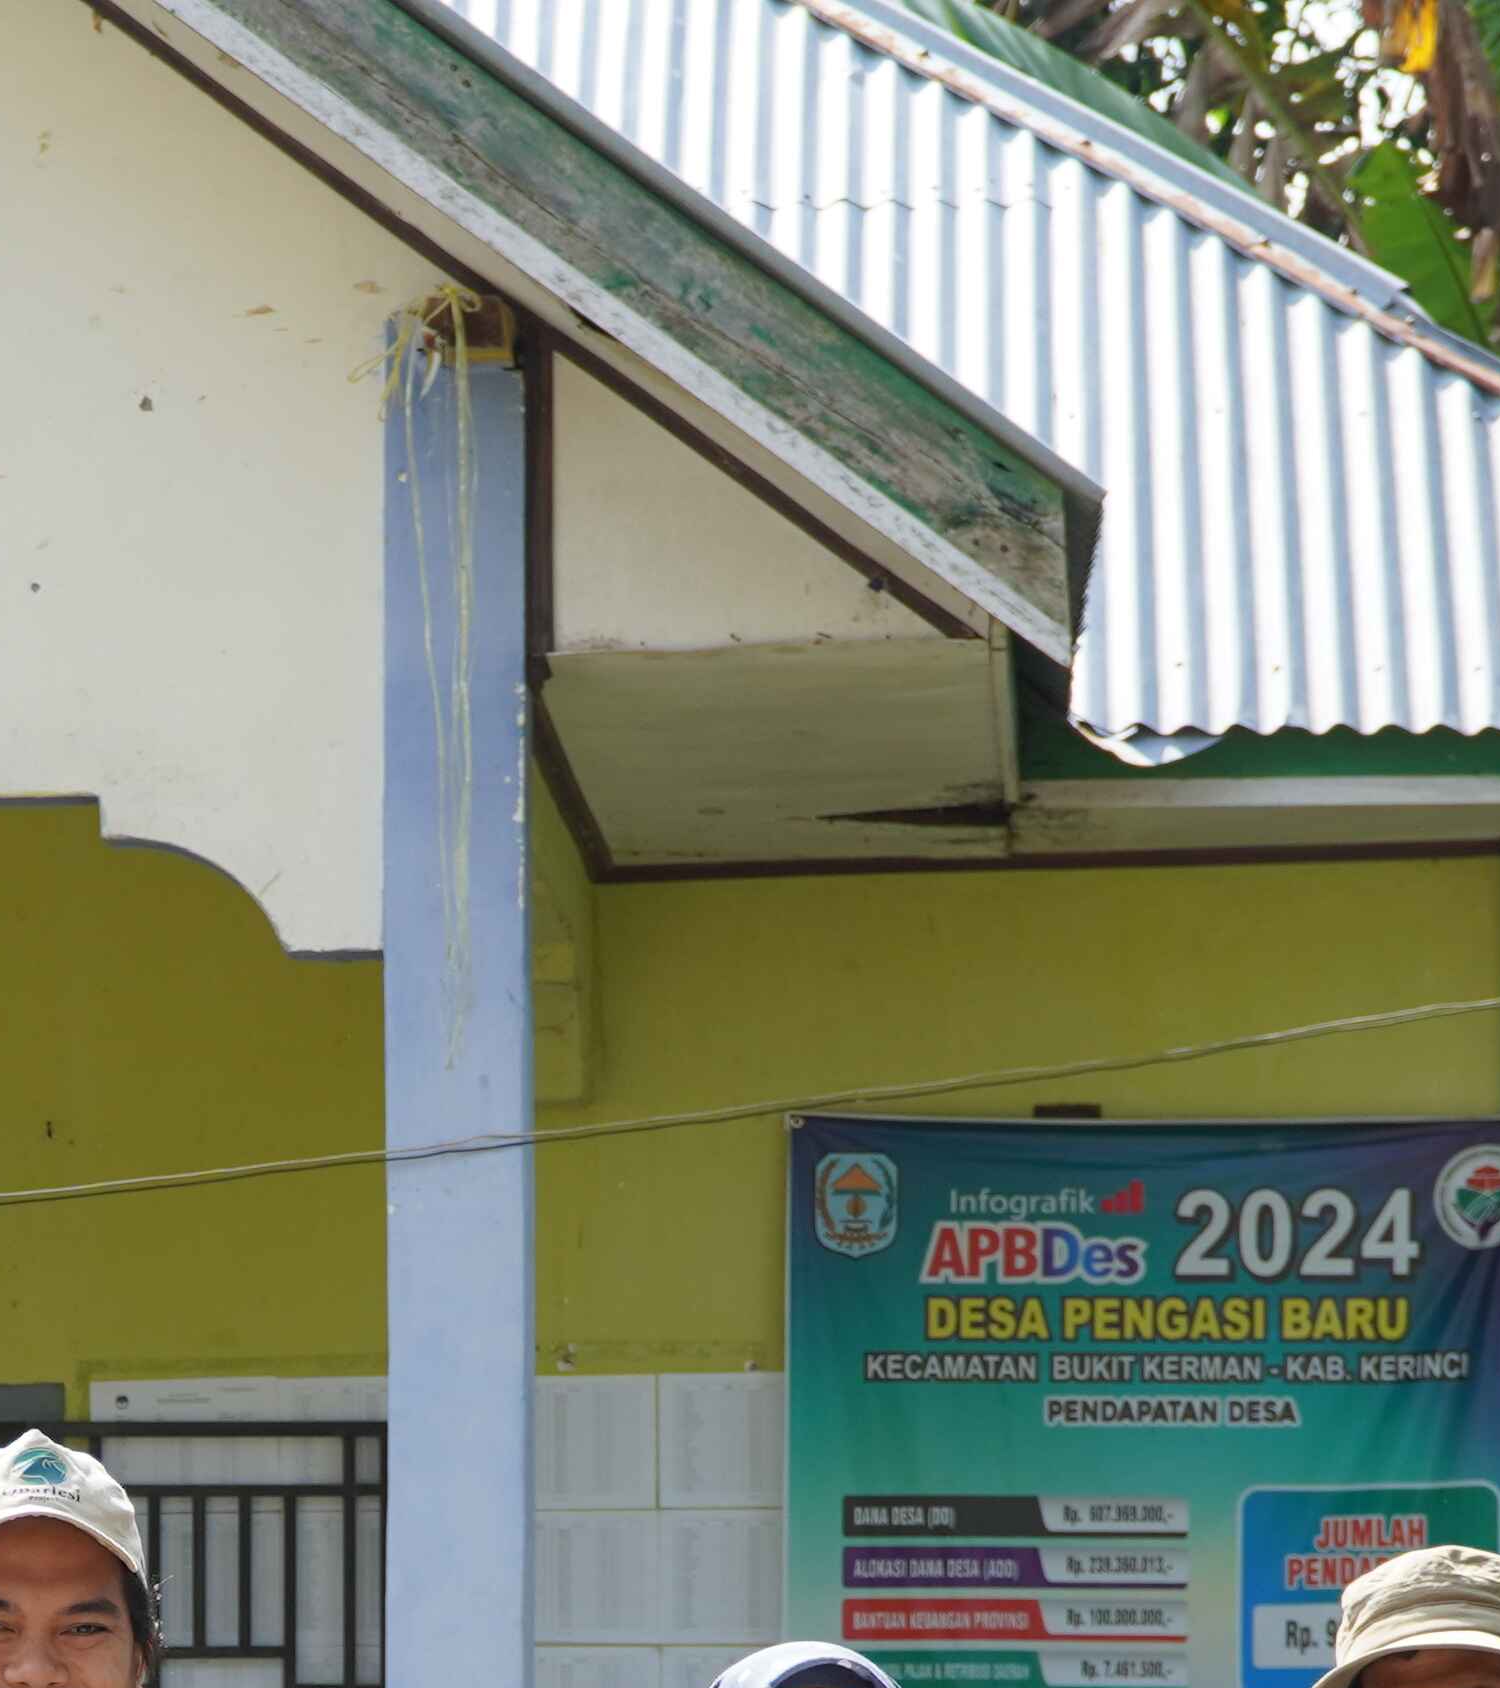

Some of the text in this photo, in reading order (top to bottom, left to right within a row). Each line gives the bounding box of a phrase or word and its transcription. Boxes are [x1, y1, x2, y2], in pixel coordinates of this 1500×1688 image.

[950, 1188, 1095, 1220] Infografik
[927, 1187, 1418, 1282] APBDes 2024
[926, 1297, 1408, 1341] DESA PENGASI BARU
[866, 1353, 1036, 1381] KECAMATAN
[1053, 1354, 1135, 1382] BUKIT
[1143, 1354, 1262, 1382] KERMAN
[1286, 1355, 1352, 1381] KAB.
[1360, 1354, 1470, 1380] KERINCI
[1047, 1400, 1297, 1424] PENDAPATAN DESA
[1313, 1515, 1427, 1549] JUMLAH
[1285, 1620, 1318, 1654] Rp.
